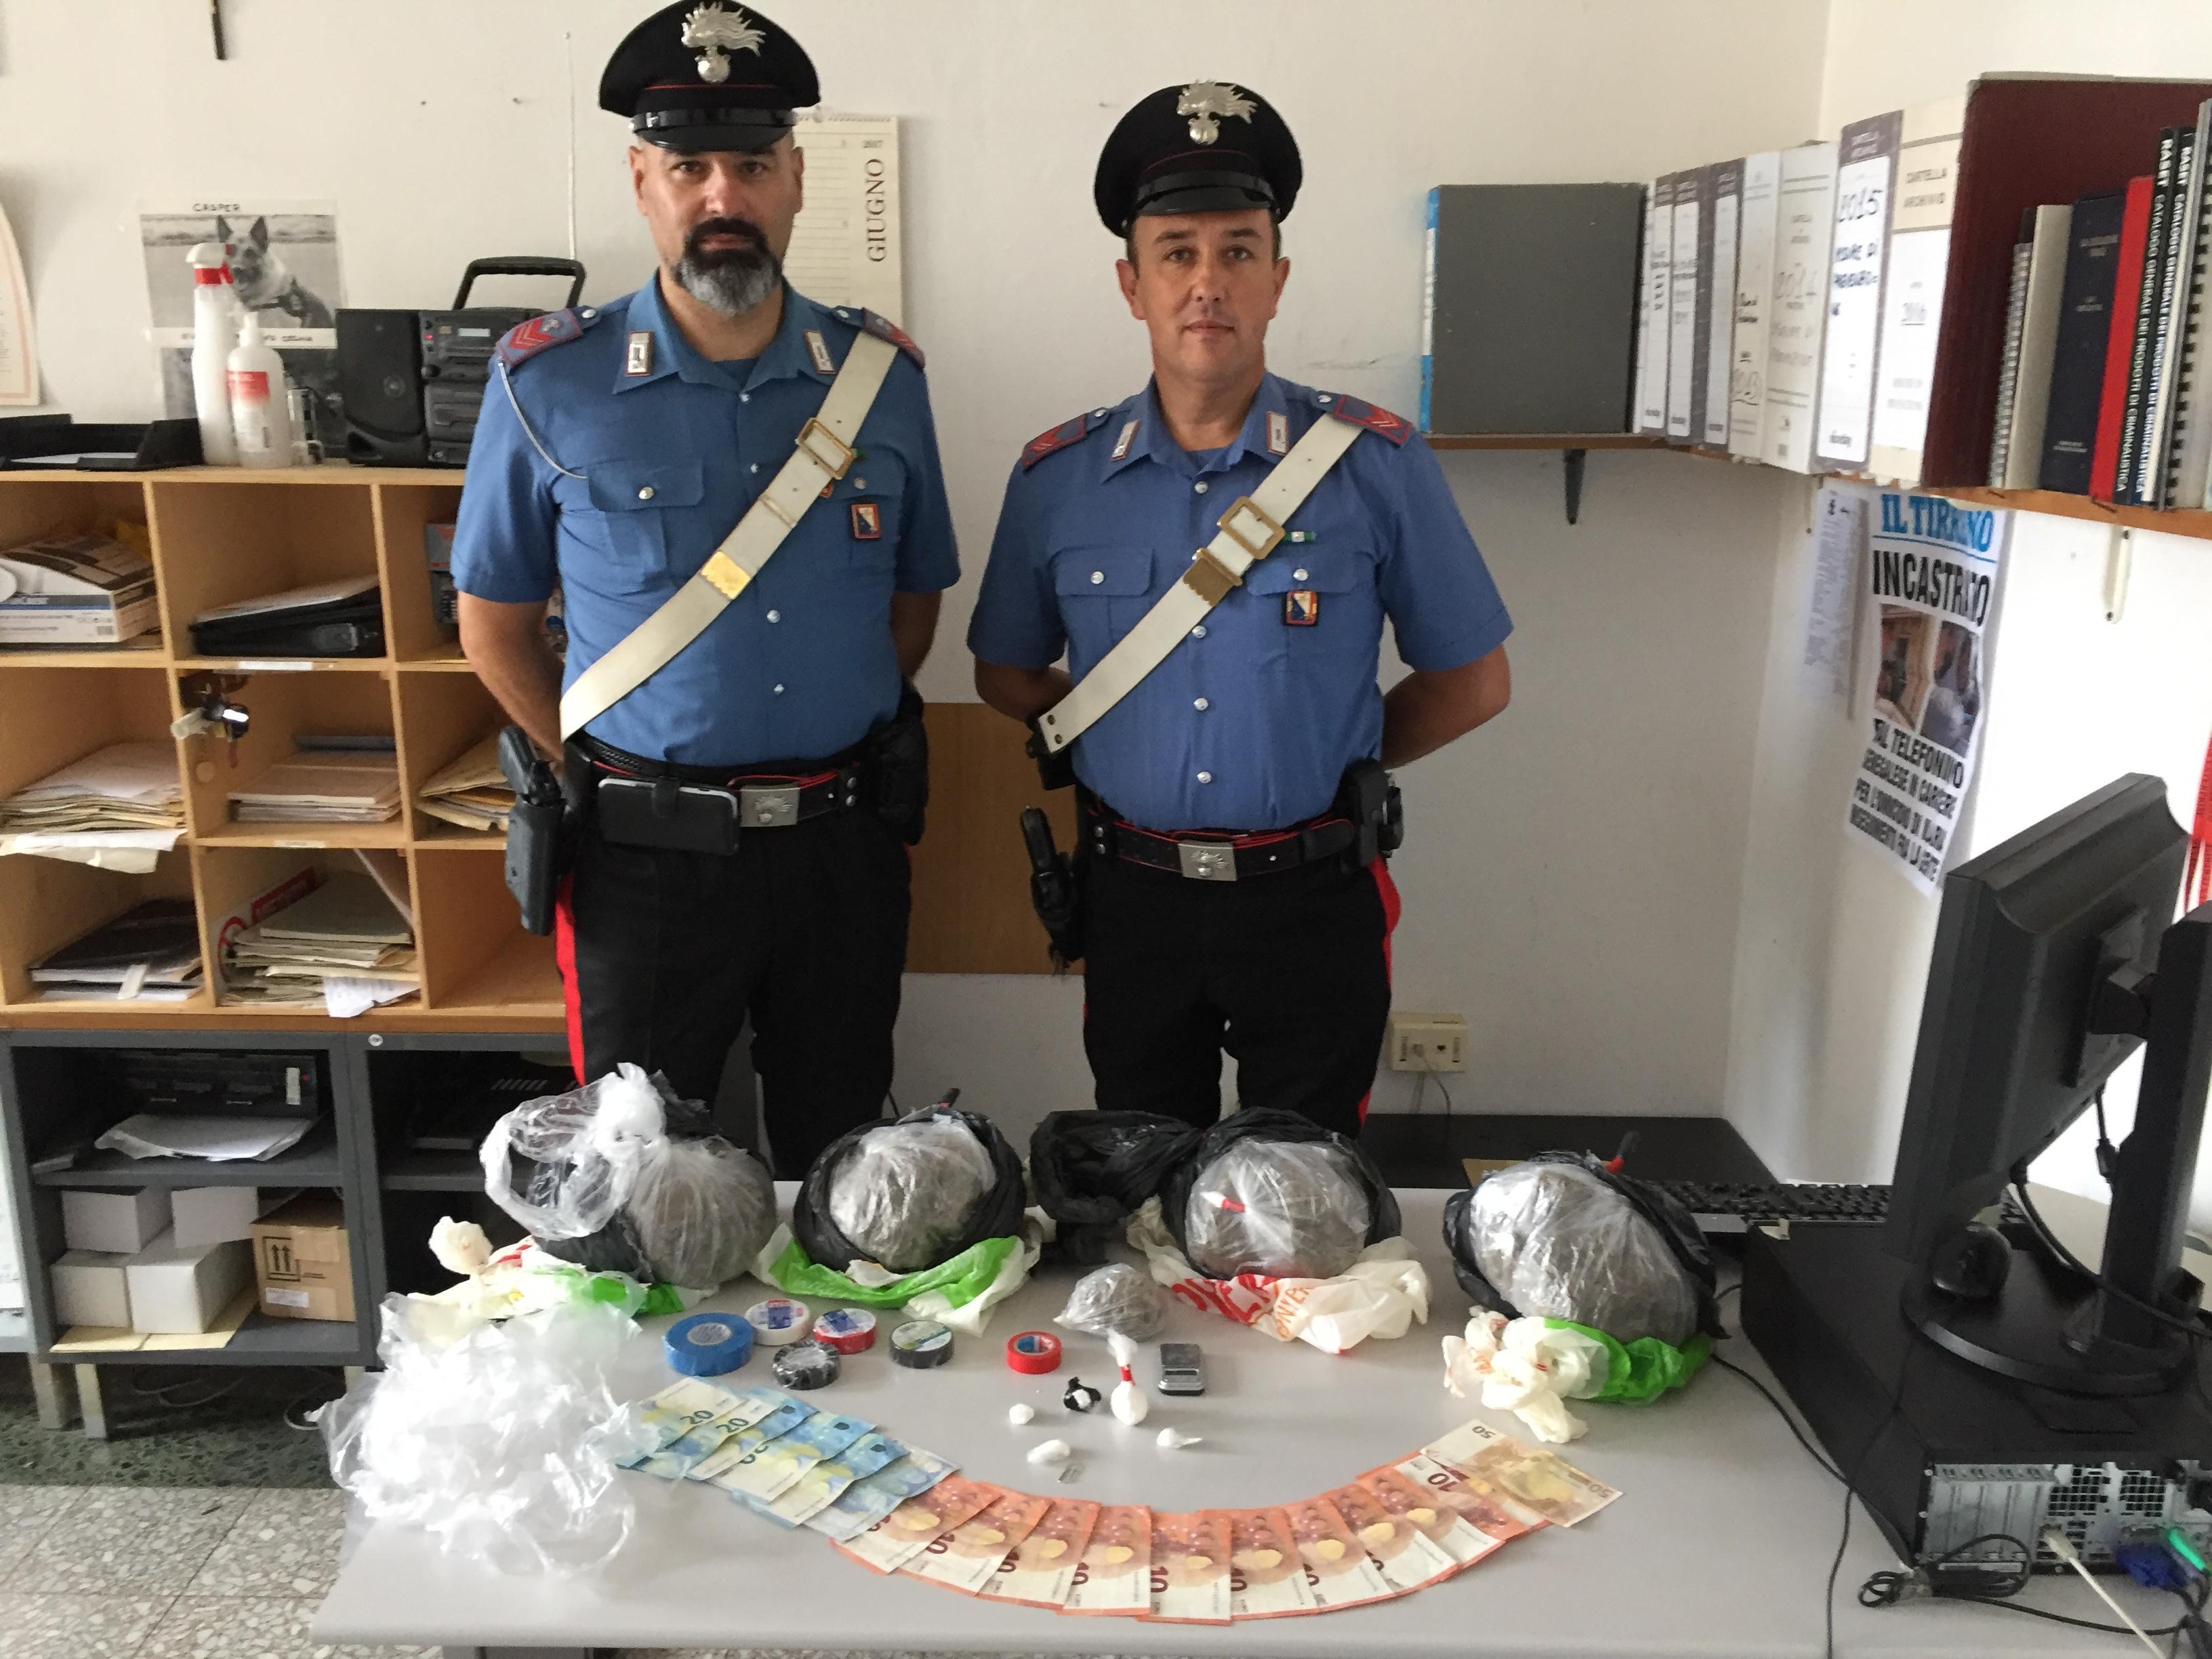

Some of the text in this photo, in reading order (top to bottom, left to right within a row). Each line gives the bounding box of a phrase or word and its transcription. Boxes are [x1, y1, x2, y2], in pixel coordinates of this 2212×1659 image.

[865, 159, 887, 262] GIUGNO
[2148, 194, 2166, 258] CATALOGO
[1881, 493, 1994, 552] IL TIRRNO
[680, 1410, 714, 1425] 20
[716, 1418, 750, 1433] 20
[1472, 1425, 1496, 1439] 50
[1427, 1472, 1459, 1493] 10
